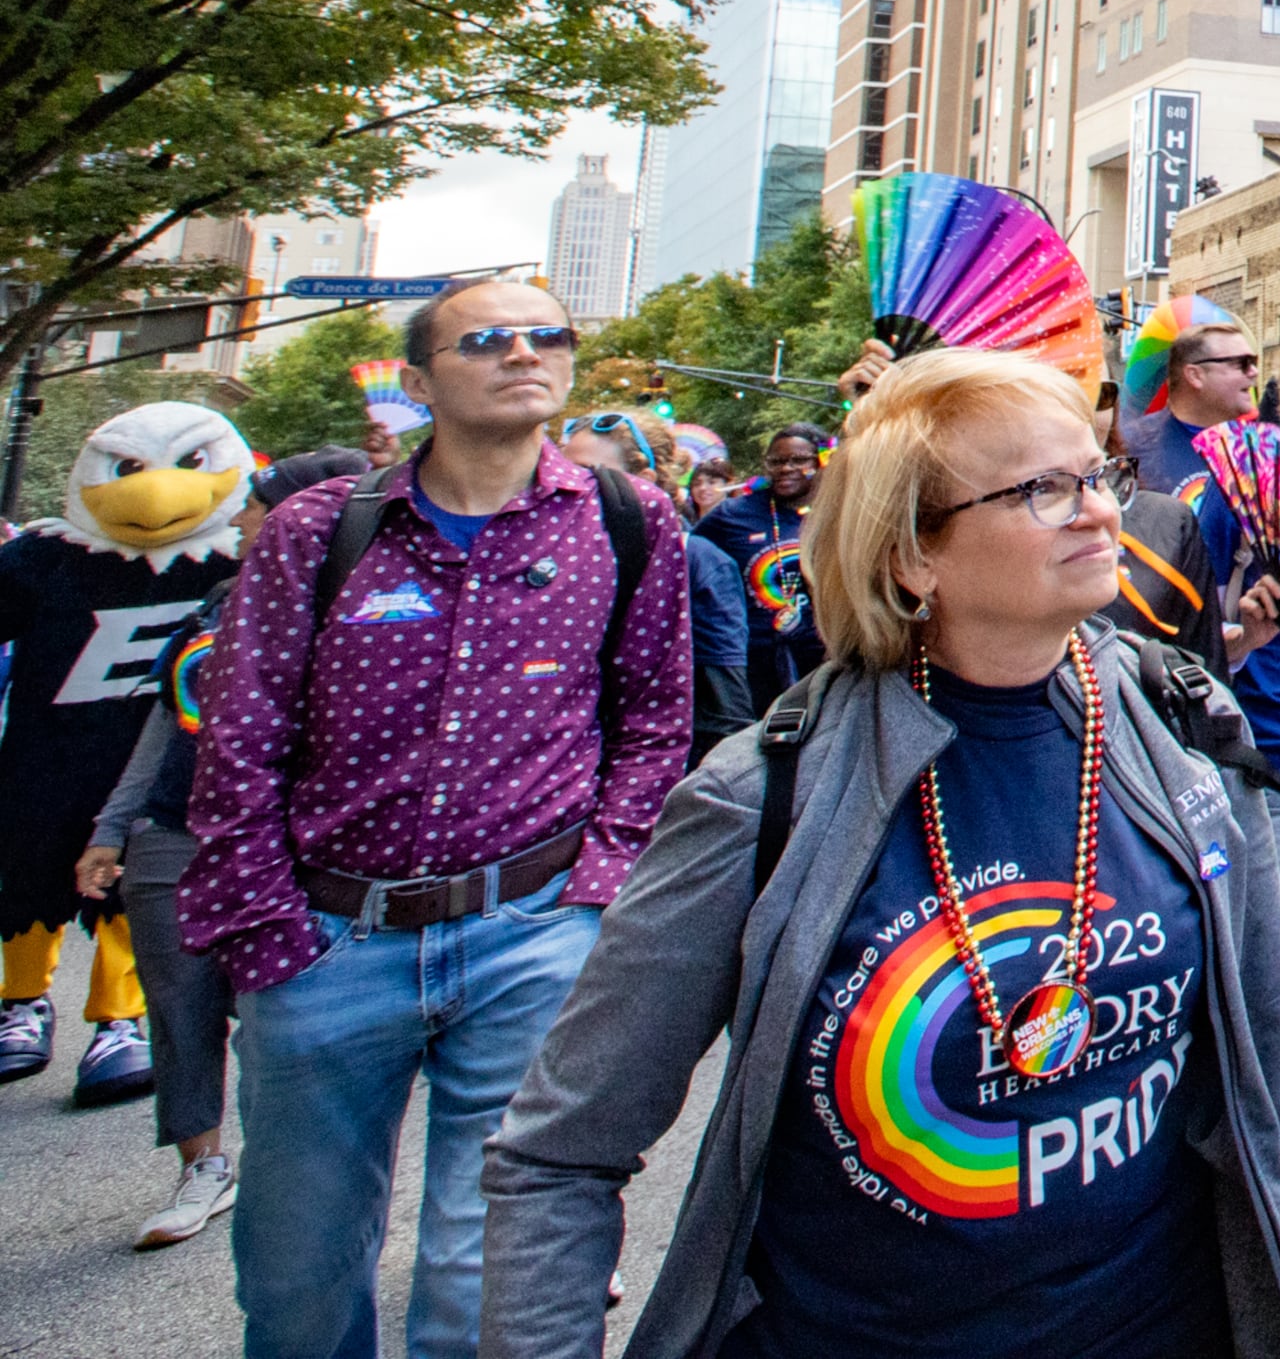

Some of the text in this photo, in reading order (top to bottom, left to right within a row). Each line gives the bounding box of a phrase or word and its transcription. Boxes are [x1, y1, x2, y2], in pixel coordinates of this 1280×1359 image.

[312, 281, 362, 294] Ponce
[367, 281, 389, 294] de
[394, 282, 434, 294] Leon
[918, 859, 1026, 921] povide.
[876, 909, 917, 944] we
[1038, 911, 1167, 982] 2023
[833, 944, 880, 1010] care
[809, 1013, 839, 1061] the
[976, 966, 1195, 1078] EORY
[1012, 1014, 1048, 1042] NEW
[1017, 1007, 1083, 1053] ORLEANS
[805, 1066, 827, 1089] in
[813, 1093, 858, 1150] pride
